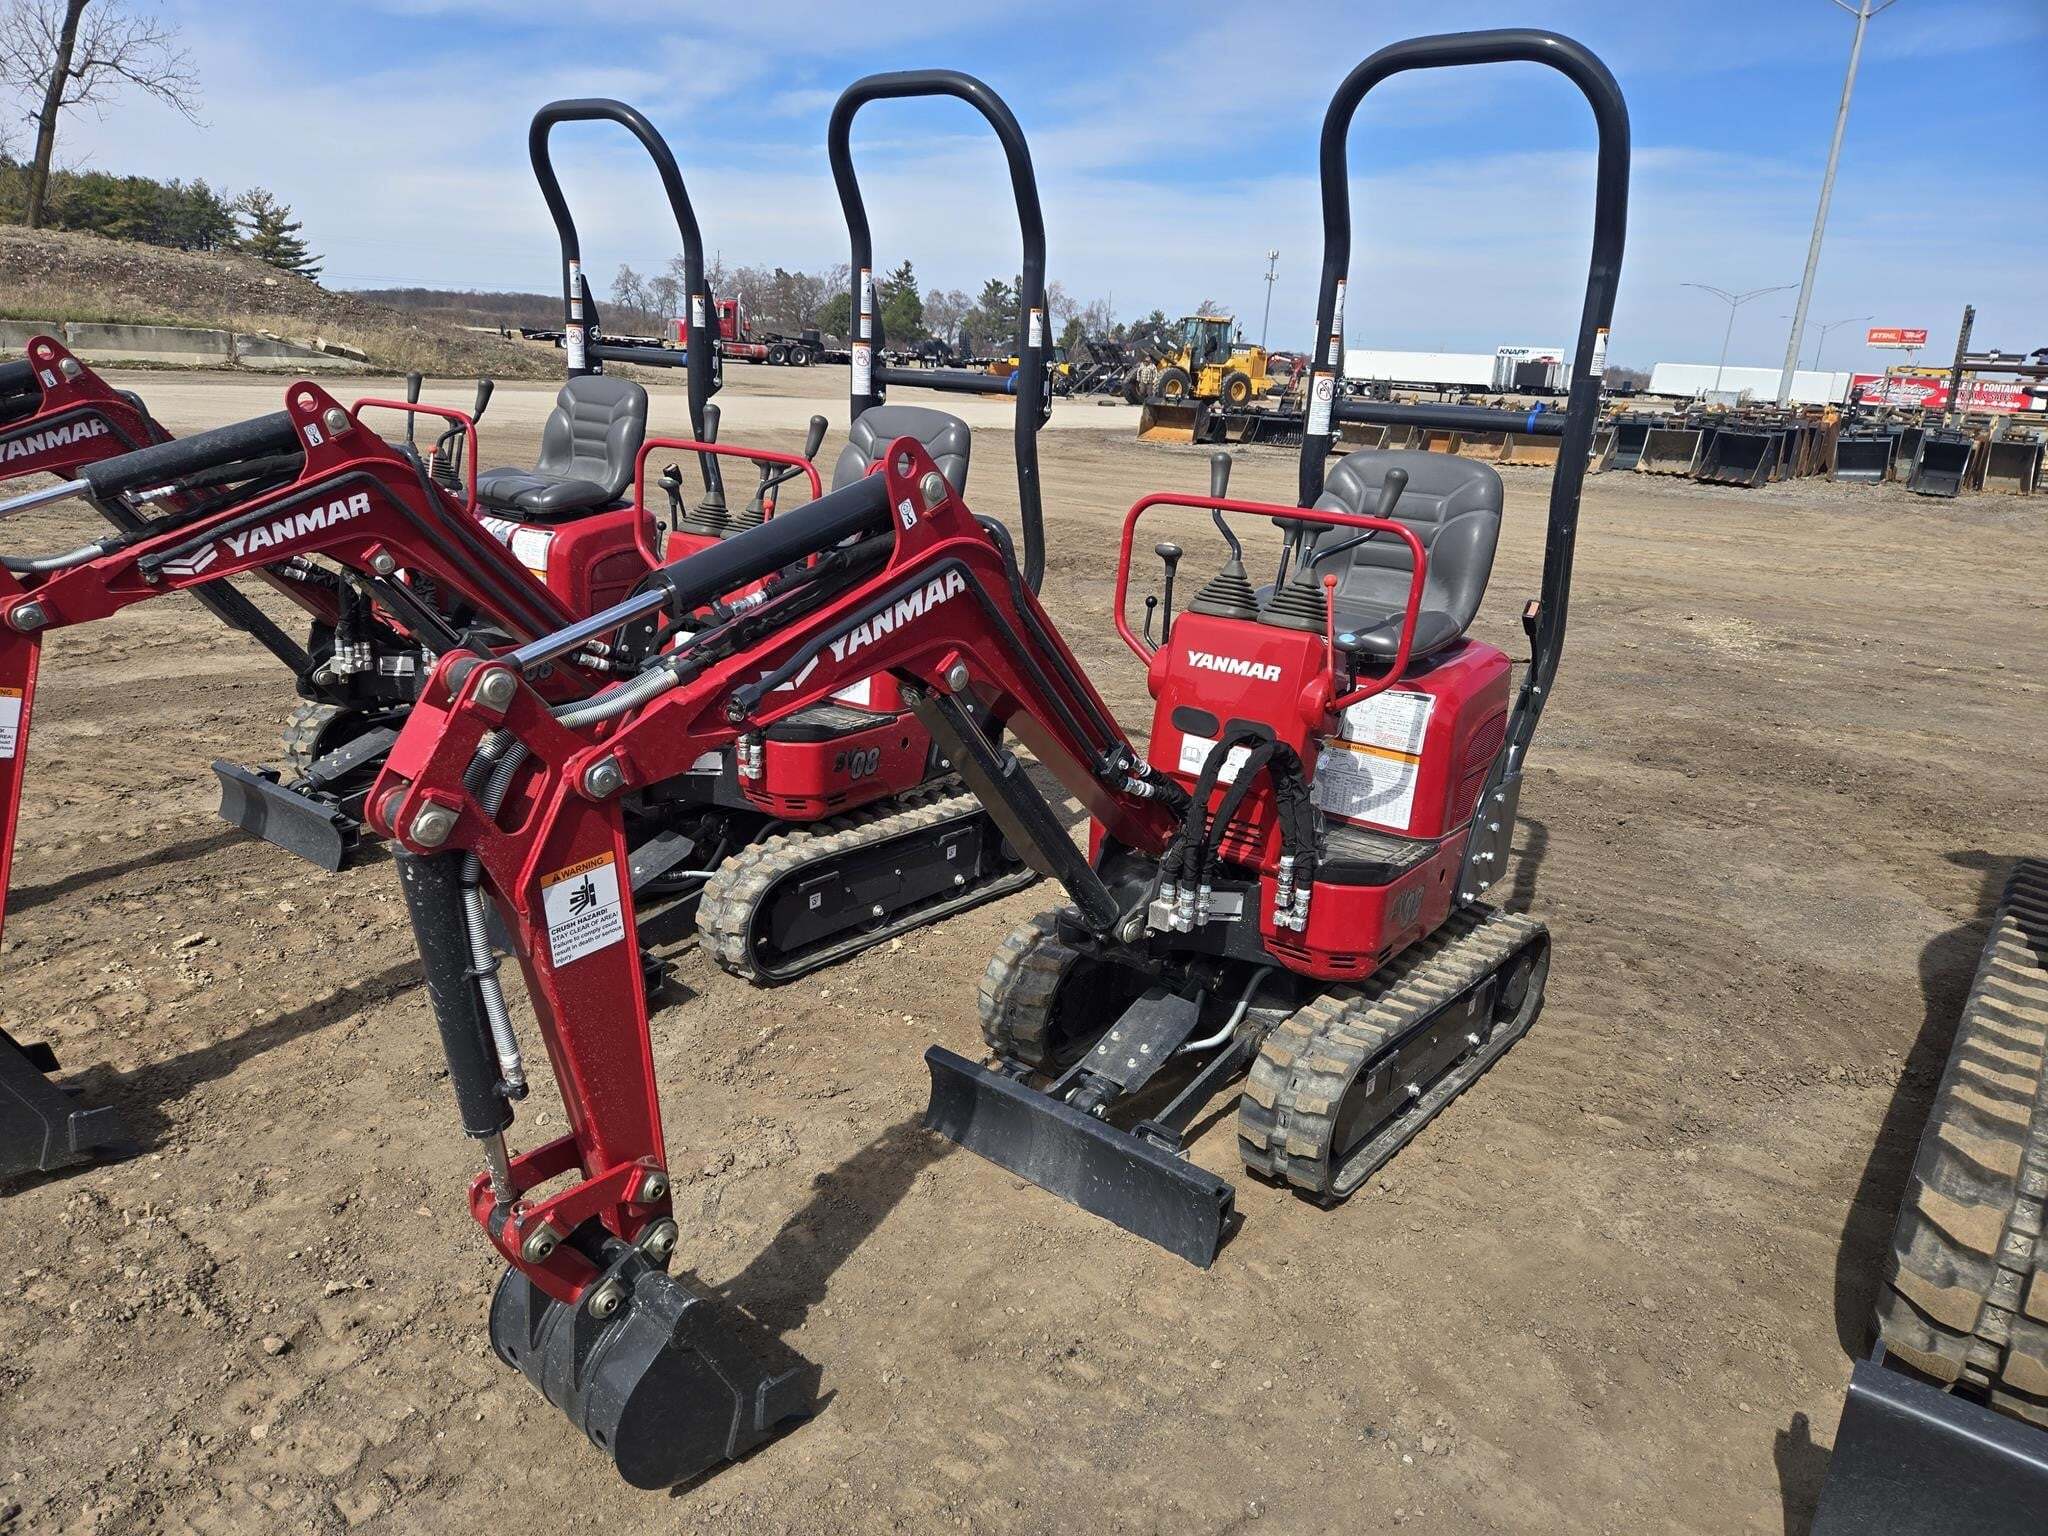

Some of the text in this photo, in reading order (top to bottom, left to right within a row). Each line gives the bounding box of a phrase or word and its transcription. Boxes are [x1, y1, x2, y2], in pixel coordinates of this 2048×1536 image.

[222, 492, 371, 558] YANMAR
[829, 569, 966, 663] YANMAR
[1187, 650, 1282, 682] YANMAR
[561, 858, 604, 878] WARNING
[551, 908, 608, 935] CRUSH HAZARD!
[552, 911, 618, 943] STAY CLEAR OF AREA!
[553, 938, 573, 950] Failure
[580, 928, 600, 940] comply
[601, 919, 618, 929] could
[554, 946, 571, 957] result
[579, 936, 595, 947] death
[602, 926, 622, 938] serious
